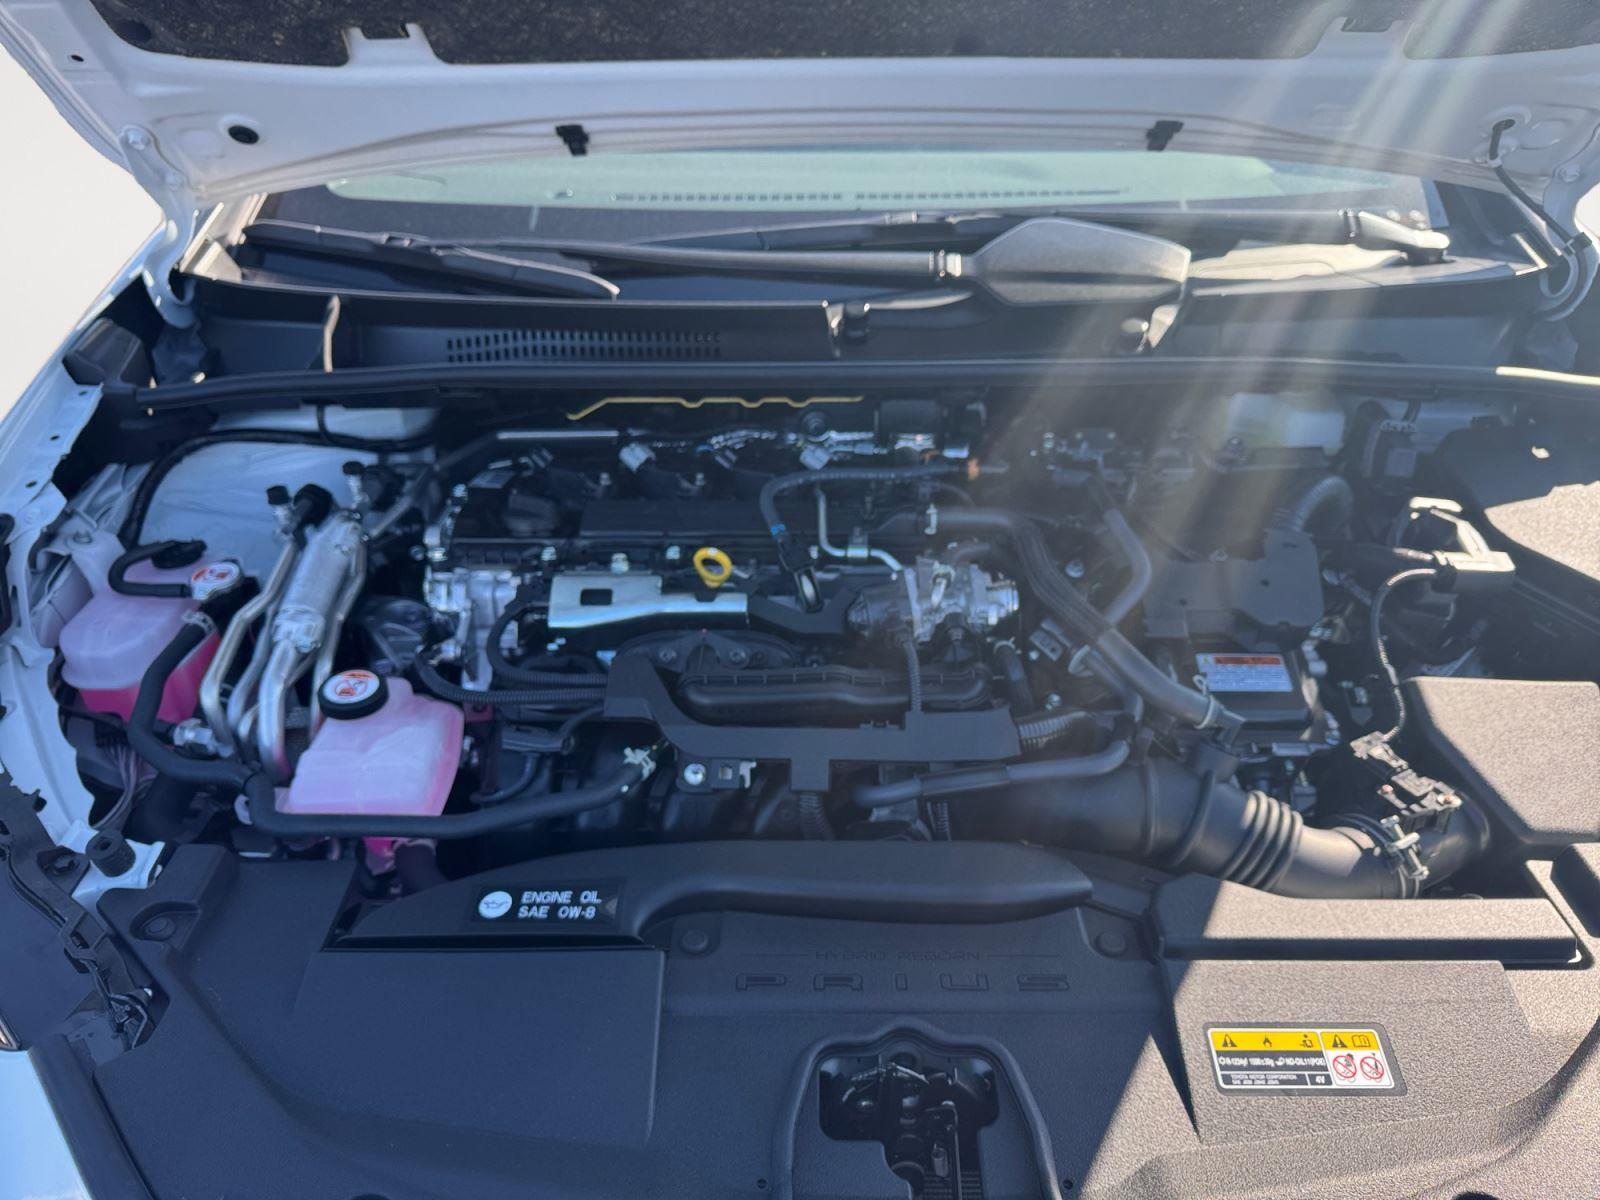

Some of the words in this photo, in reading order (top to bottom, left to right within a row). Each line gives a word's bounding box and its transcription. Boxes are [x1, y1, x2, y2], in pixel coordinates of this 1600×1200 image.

[520, 890, 574, 904] ENGINE
[579, 890, 602, 904] OIL
[517, 905, 550, 919] SAE
[557, 905, 597, 919] 0W-8
[815, 950, 887, 961] HYBRID
[897, 950, 981, 961] REBORN
[735, 972, 1070, 992] PRIUS
